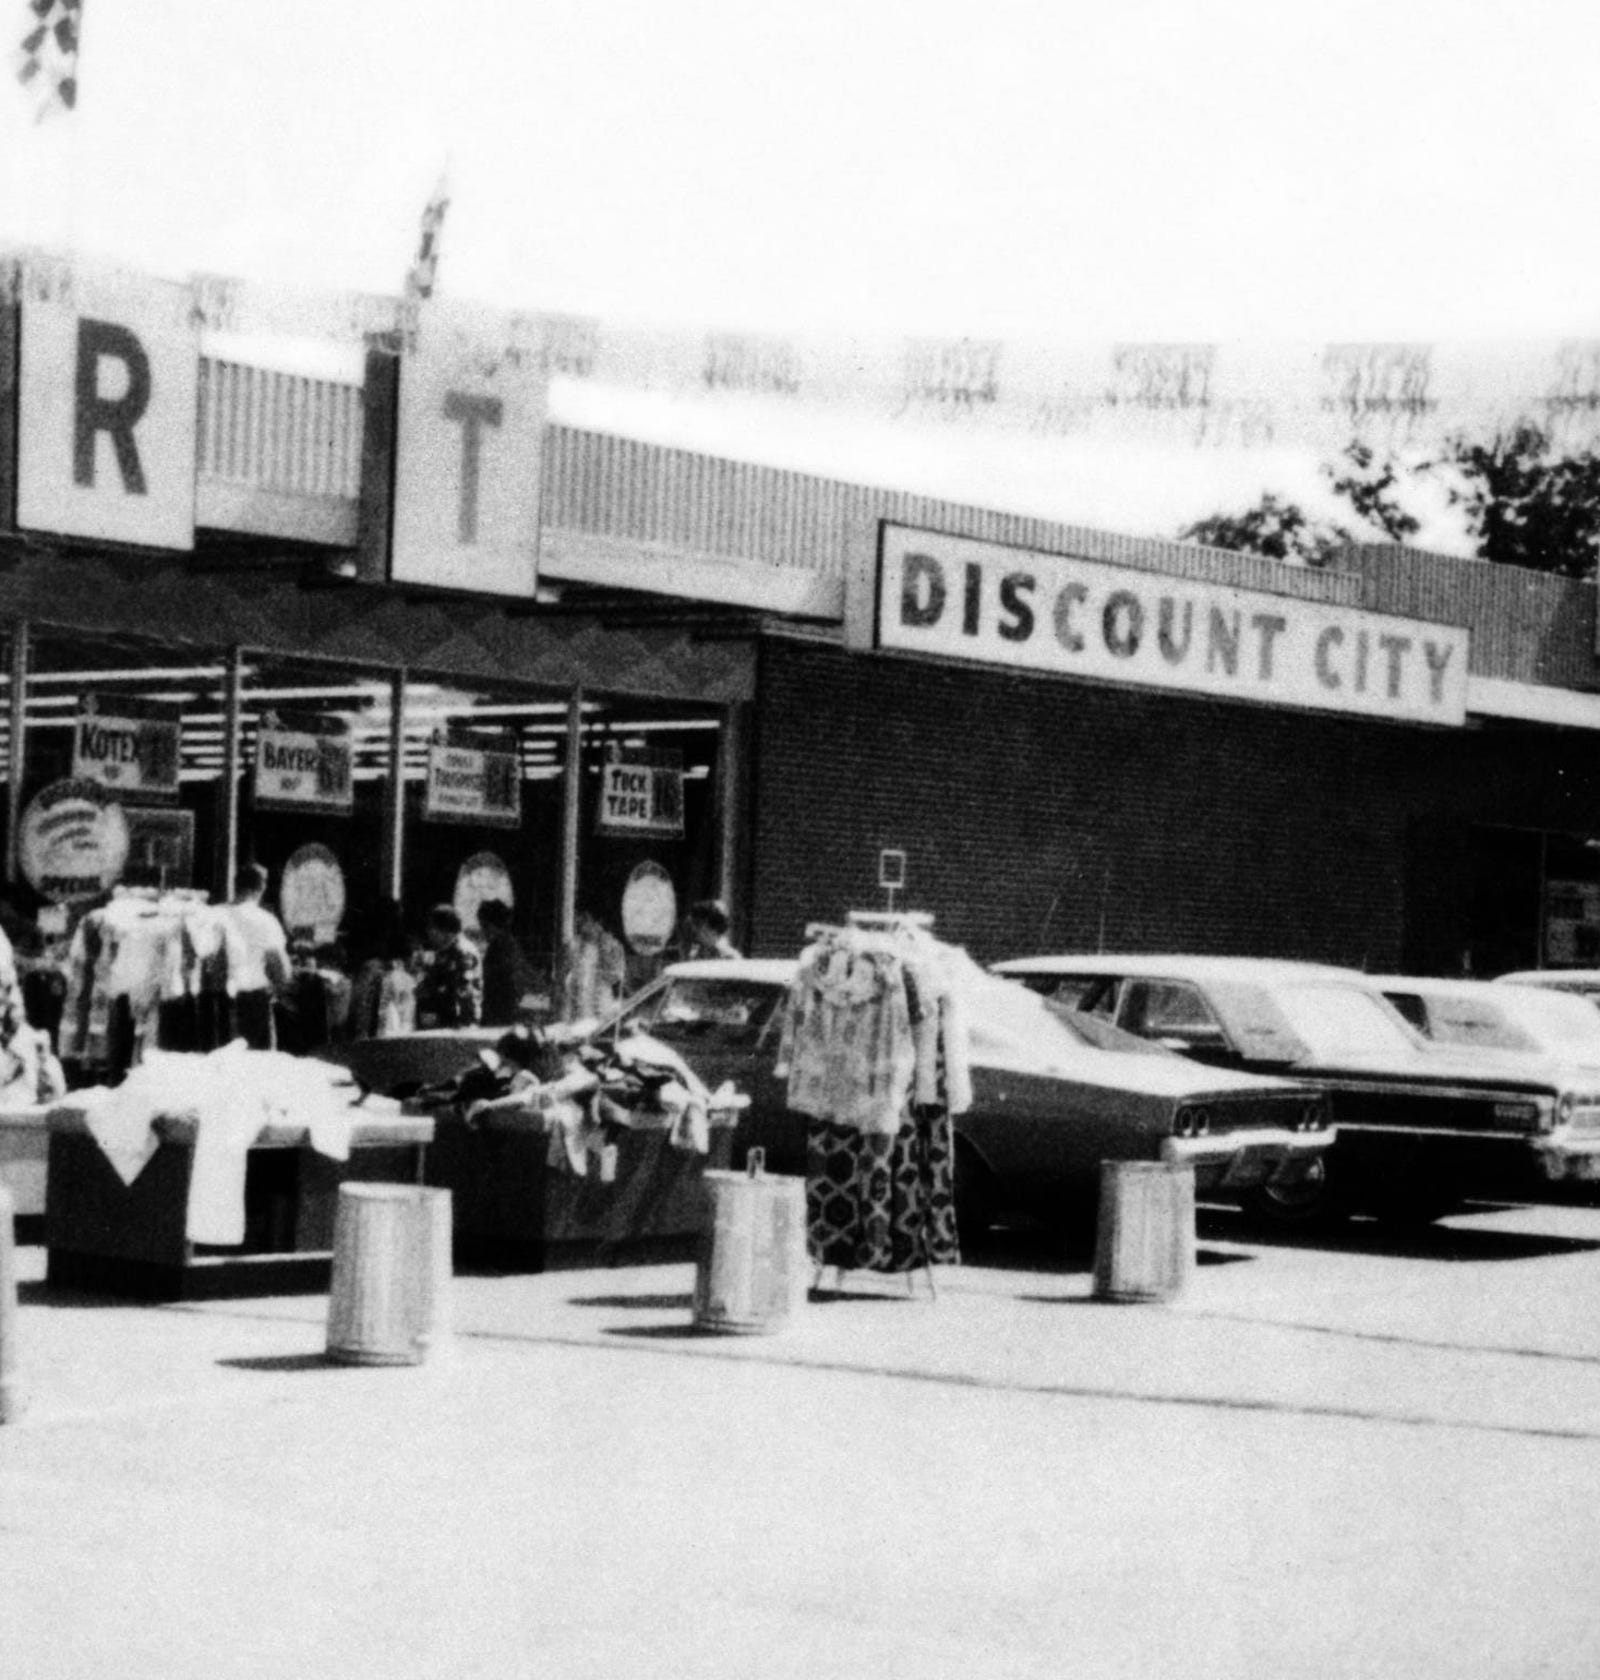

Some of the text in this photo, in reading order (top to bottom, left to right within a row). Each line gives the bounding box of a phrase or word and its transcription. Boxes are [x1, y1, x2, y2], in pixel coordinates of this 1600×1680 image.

[898, 551, 1457, 703] DISCOUNT CITY
[81, 723, 138, 762] KOTEX
[264, 741, 318, 772] BAYER
[608, 796, 647, 818] TAPE
